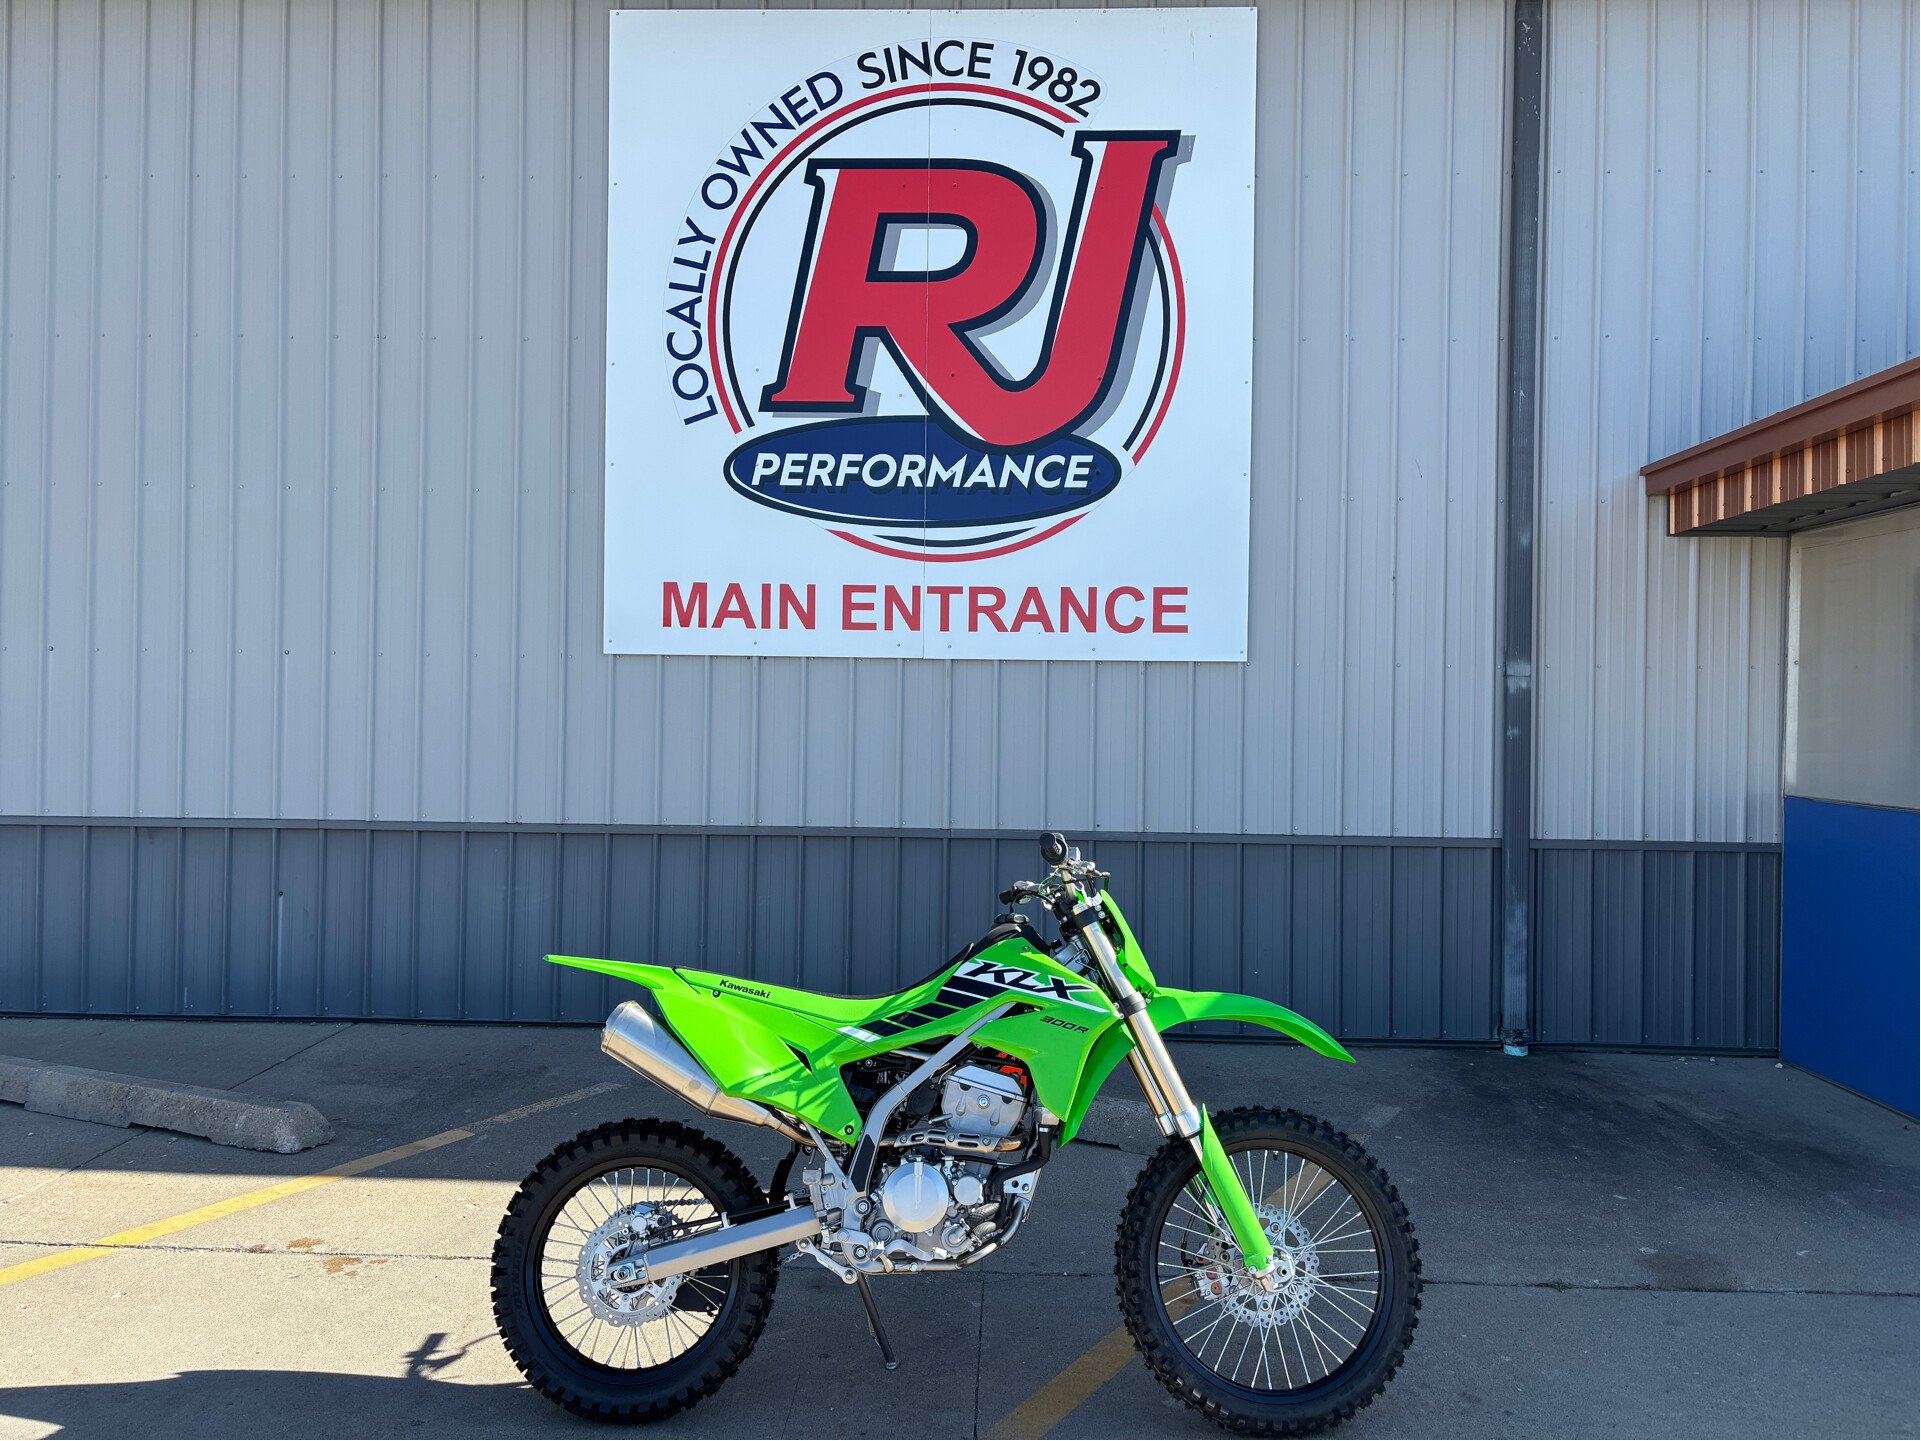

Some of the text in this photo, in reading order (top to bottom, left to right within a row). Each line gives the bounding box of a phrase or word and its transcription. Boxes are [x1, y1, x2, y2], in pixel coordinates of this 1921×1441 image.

[666, 40, 1101, 426] LOCALLY OWNED SINCE 1982
[759, 129, 1182, 454] RJ
[750, 452, 1095, 489] PERFORMANCE
[662, 582, 1188, 634] MAIN ENTRANCE
[719, 979, 771, 999] Kawasaki
[963, 960, 1093, 1002] KLX
[1040, 1015, 1090, 1034] 300R
